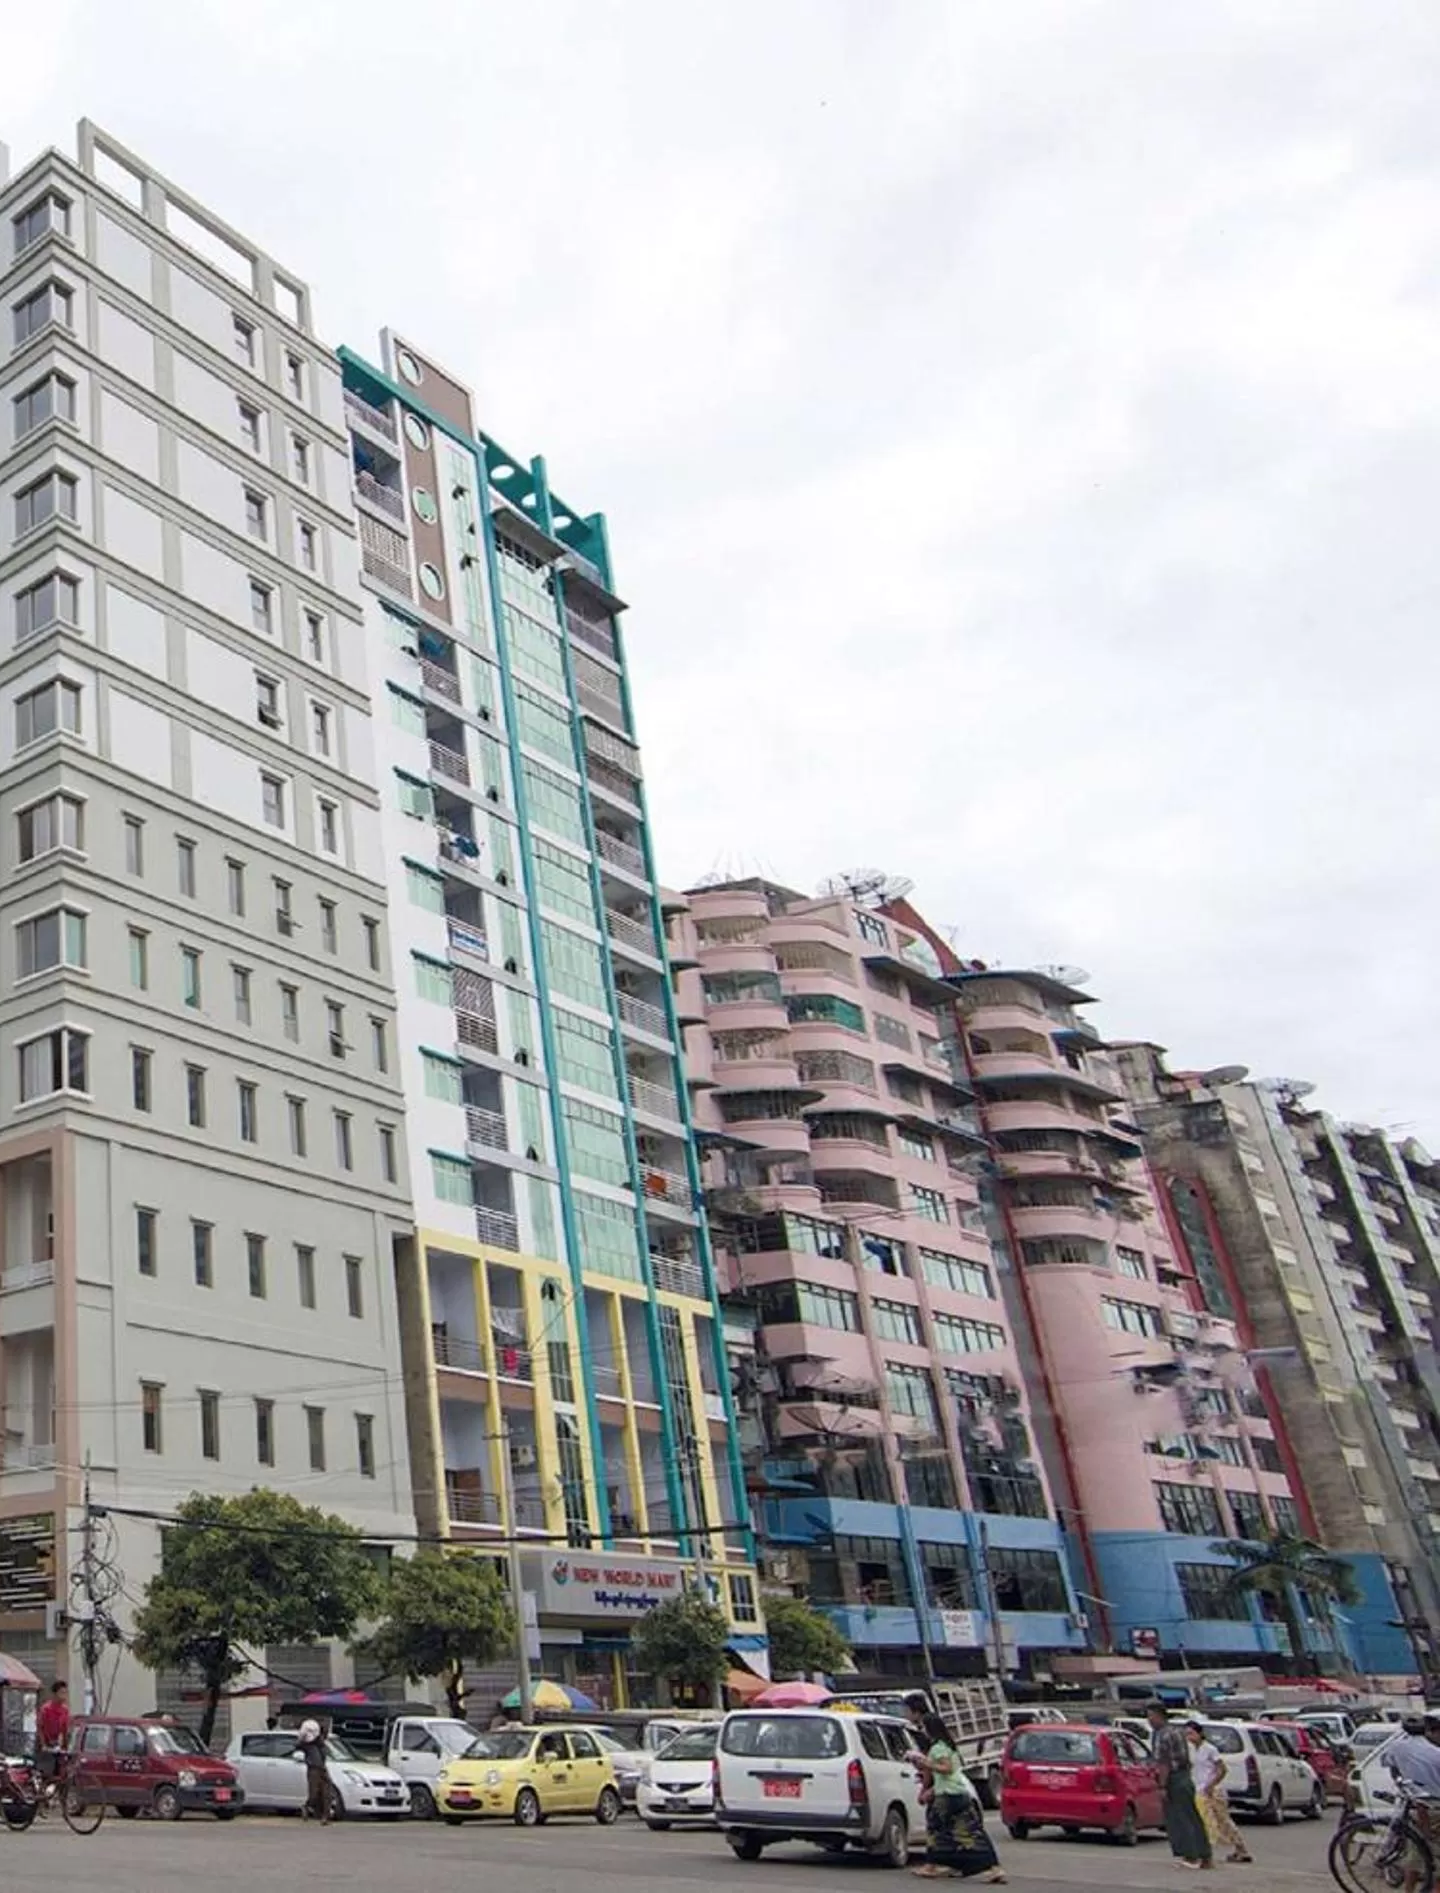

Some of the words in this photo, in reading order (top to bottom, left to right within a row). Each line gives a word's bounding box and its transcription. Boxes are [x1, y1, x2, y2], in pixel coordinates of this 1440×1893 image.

[573, 1566, 599, 1584] NEW
[603, 1569, 644, 1586] WORLD
[648, 1572, 676, 1588] MART
